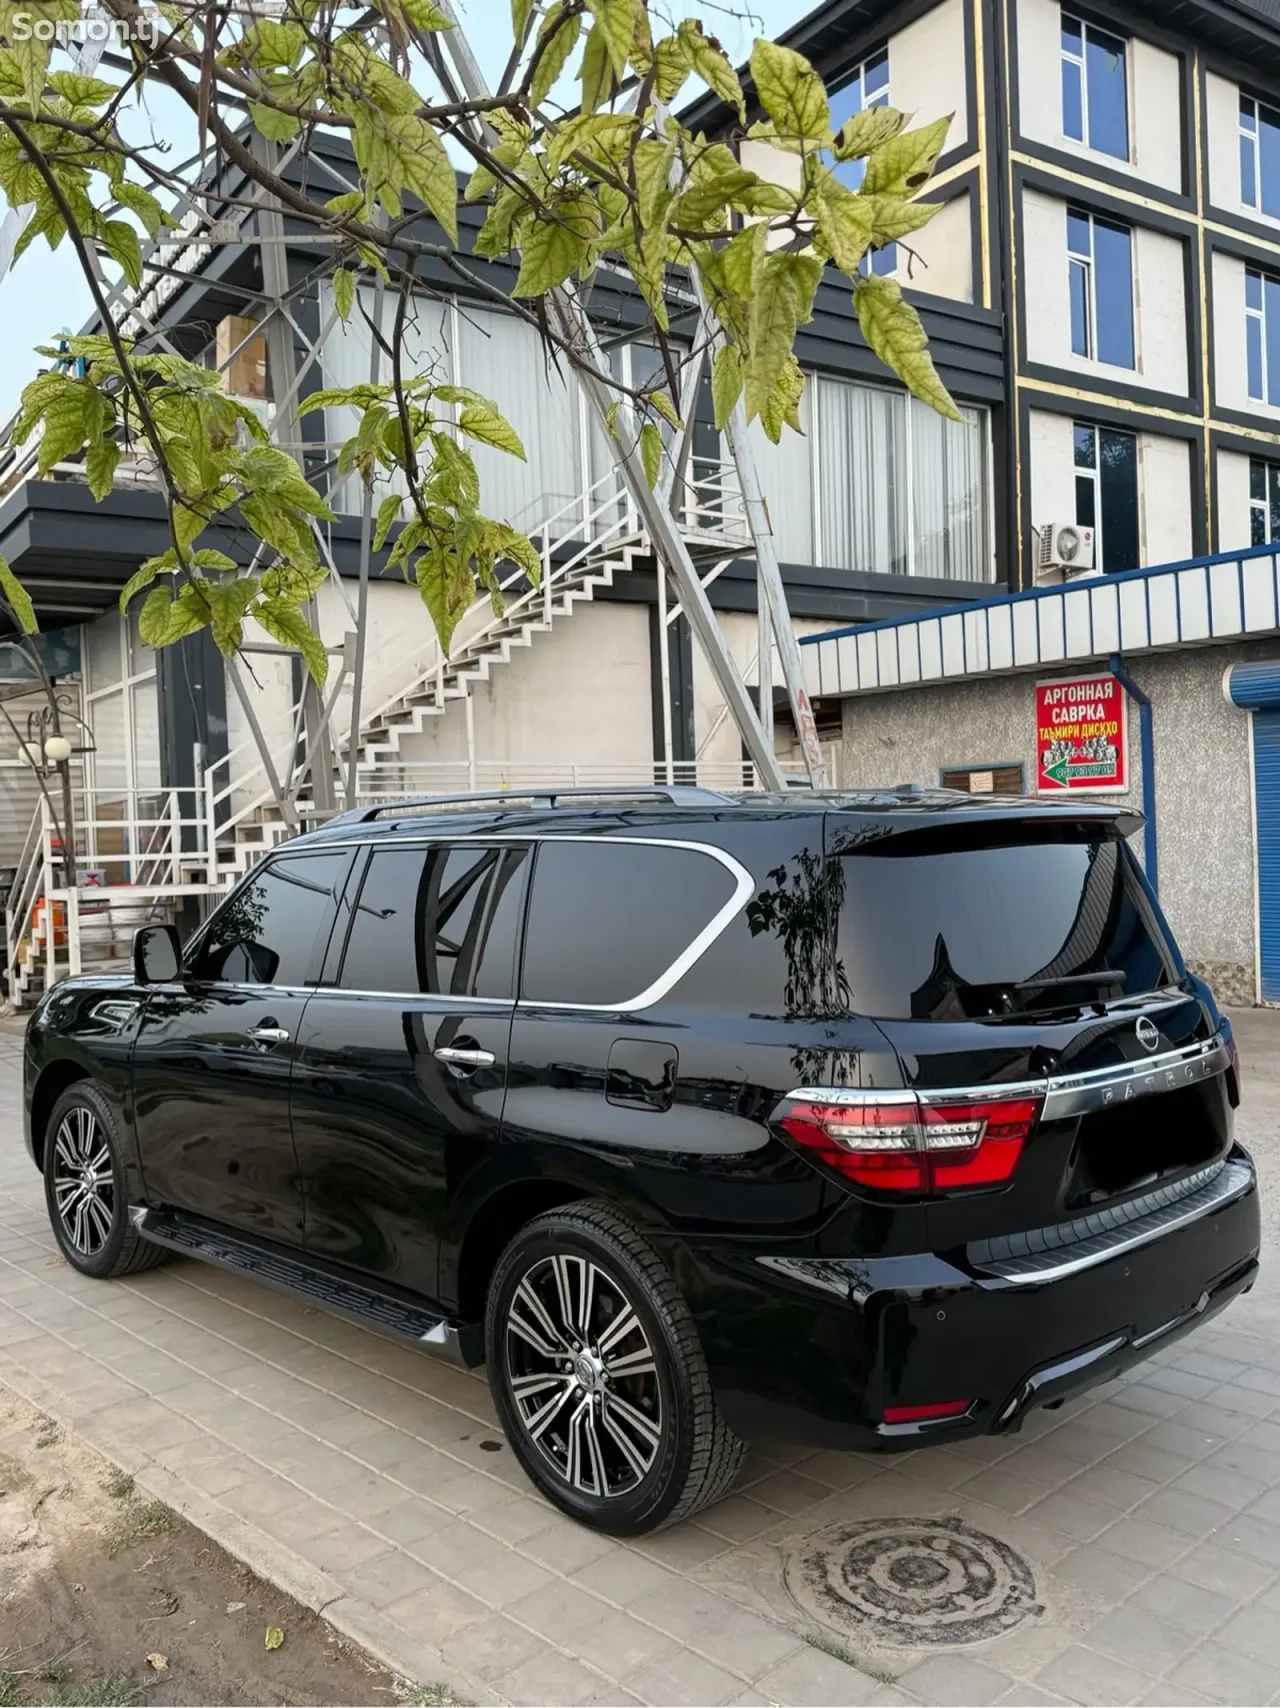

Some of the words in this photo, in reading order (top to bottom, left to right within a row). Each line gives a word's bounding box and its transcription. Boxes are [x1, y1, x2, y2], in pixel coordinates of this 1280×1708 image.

[1044, 682, 1113, 706] АРГОННАЯ
[1052, 703, 1106, 724] САВРКА
[1039, 725, 1080, 741] ТАЪМИРИ
[1056, 767, 1074, 779] 907
[1100, 1060, 1211, 1105] PATROL
